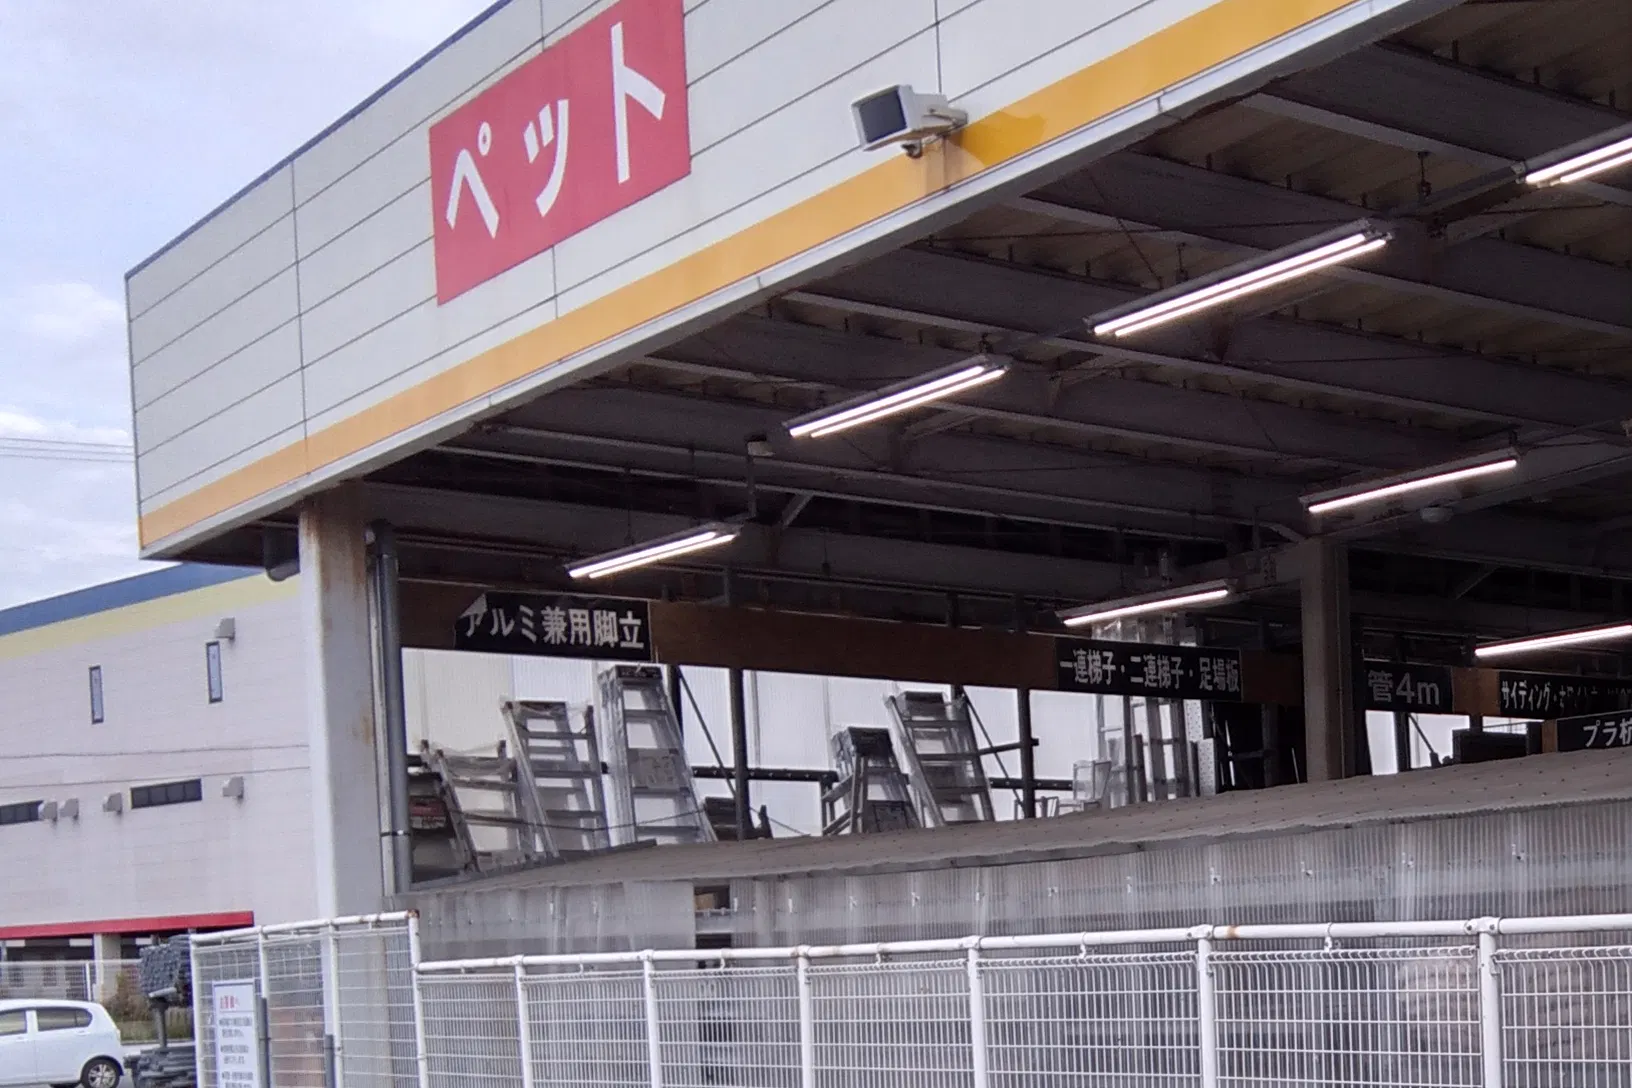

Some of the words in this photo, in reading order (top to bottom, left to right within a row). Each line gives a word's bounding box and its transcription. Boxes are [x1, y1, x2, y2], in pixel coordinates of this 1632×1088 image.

[446, 22, 666, 239] ペット
[463, 604, 645, 649] アルミ兼用脚立
